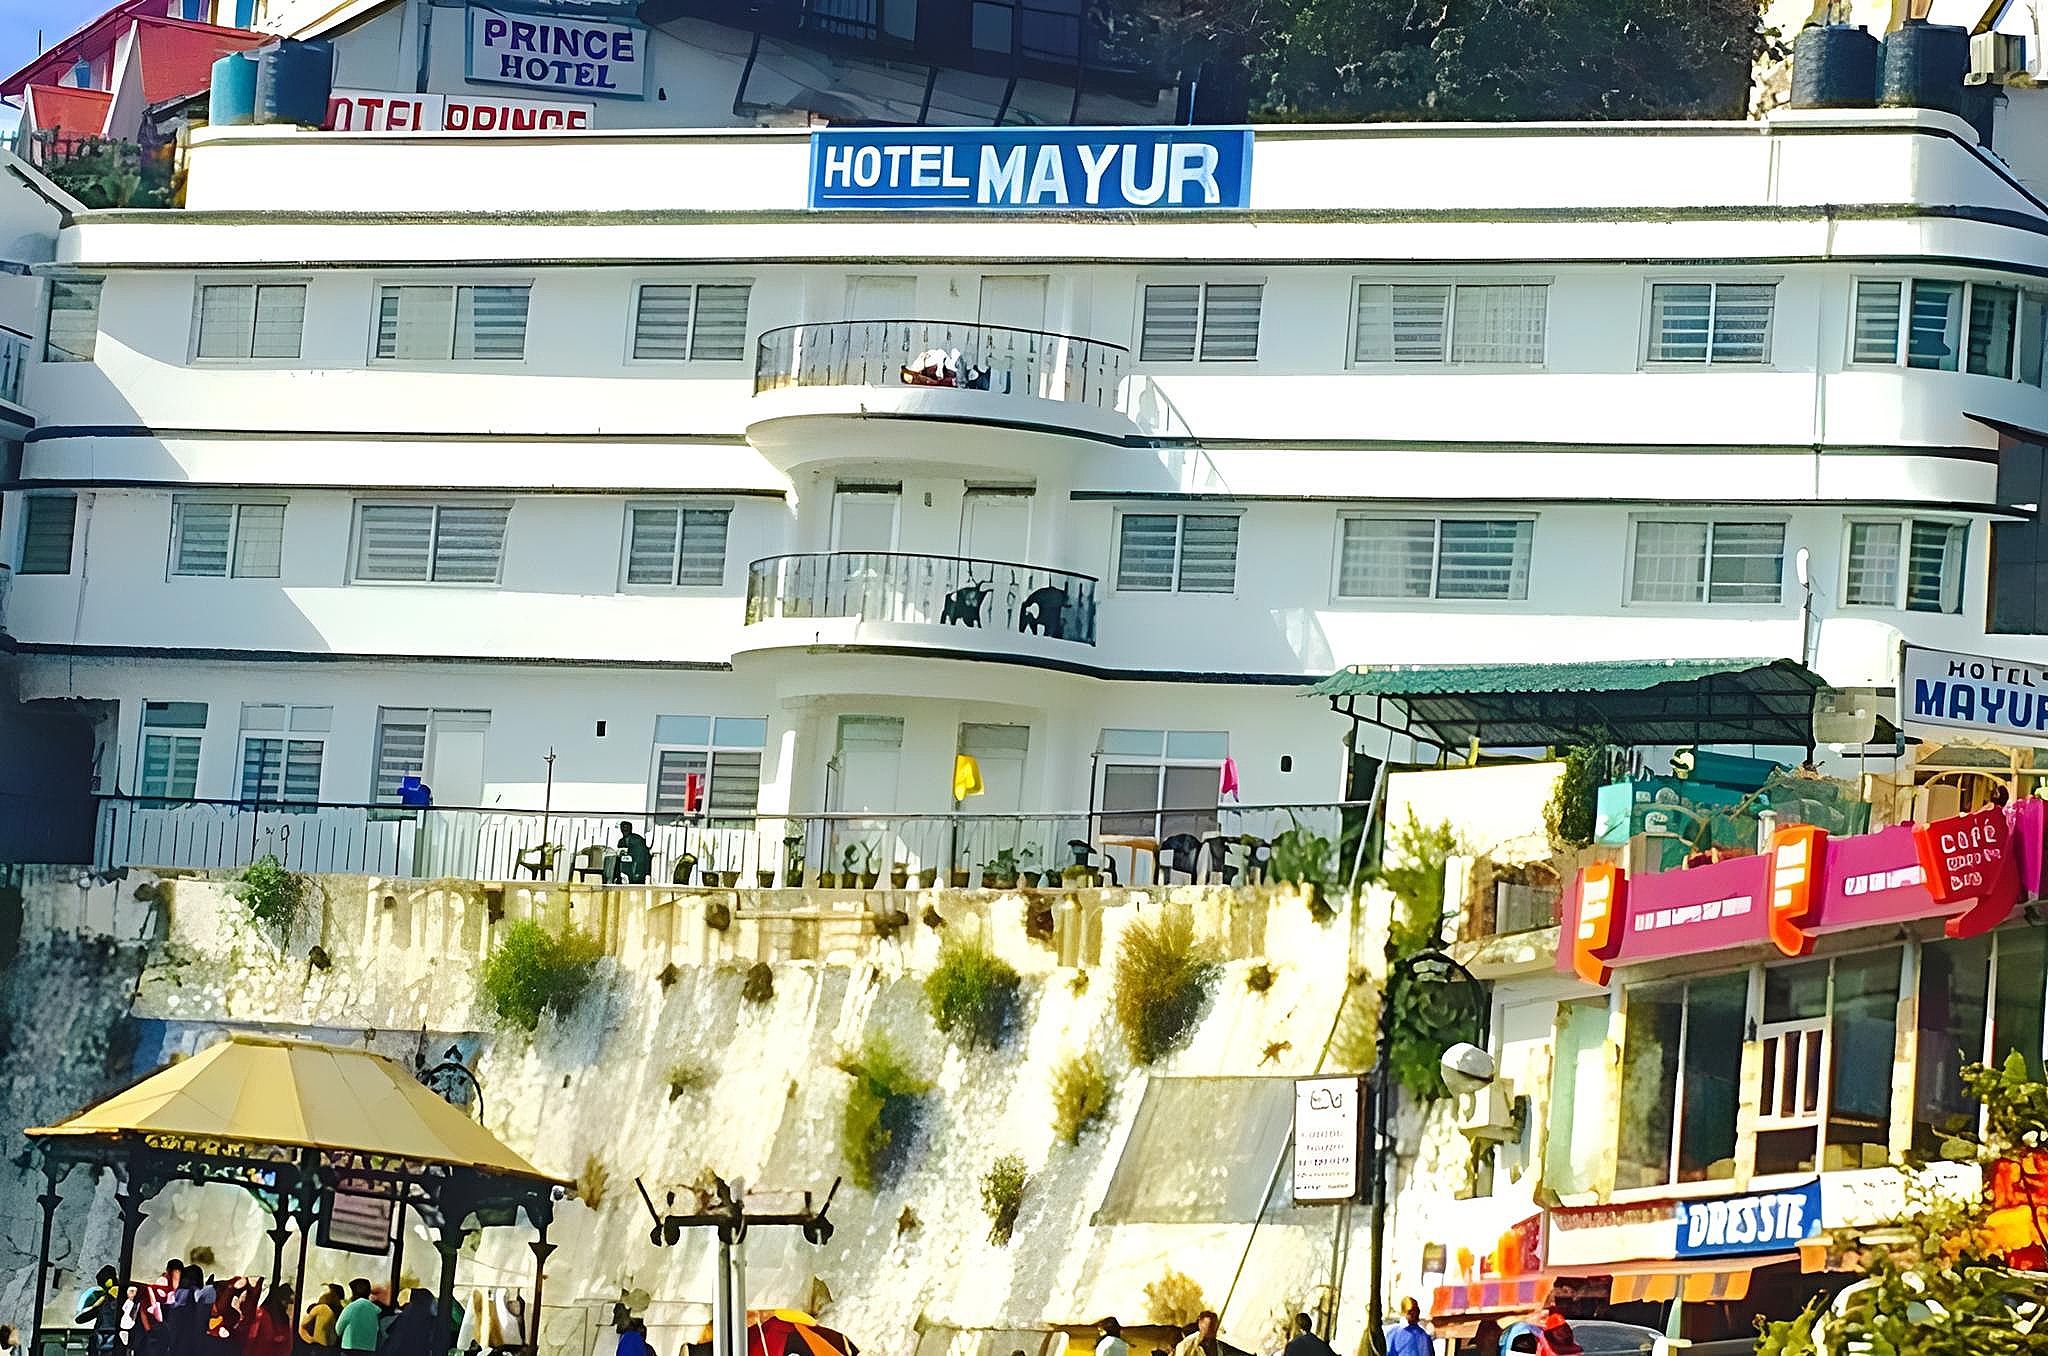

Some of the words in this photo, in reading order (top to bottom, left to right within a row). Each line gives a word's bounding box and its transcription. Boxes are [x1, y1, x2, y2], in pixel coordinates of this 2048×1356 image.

[484, 18, 635, 62] PRINCE
[499, 53, 617, 90] HOTEL
[823, 144, 970, 188] HOTEL
[976, 142, 1221, 206] MAYUR
